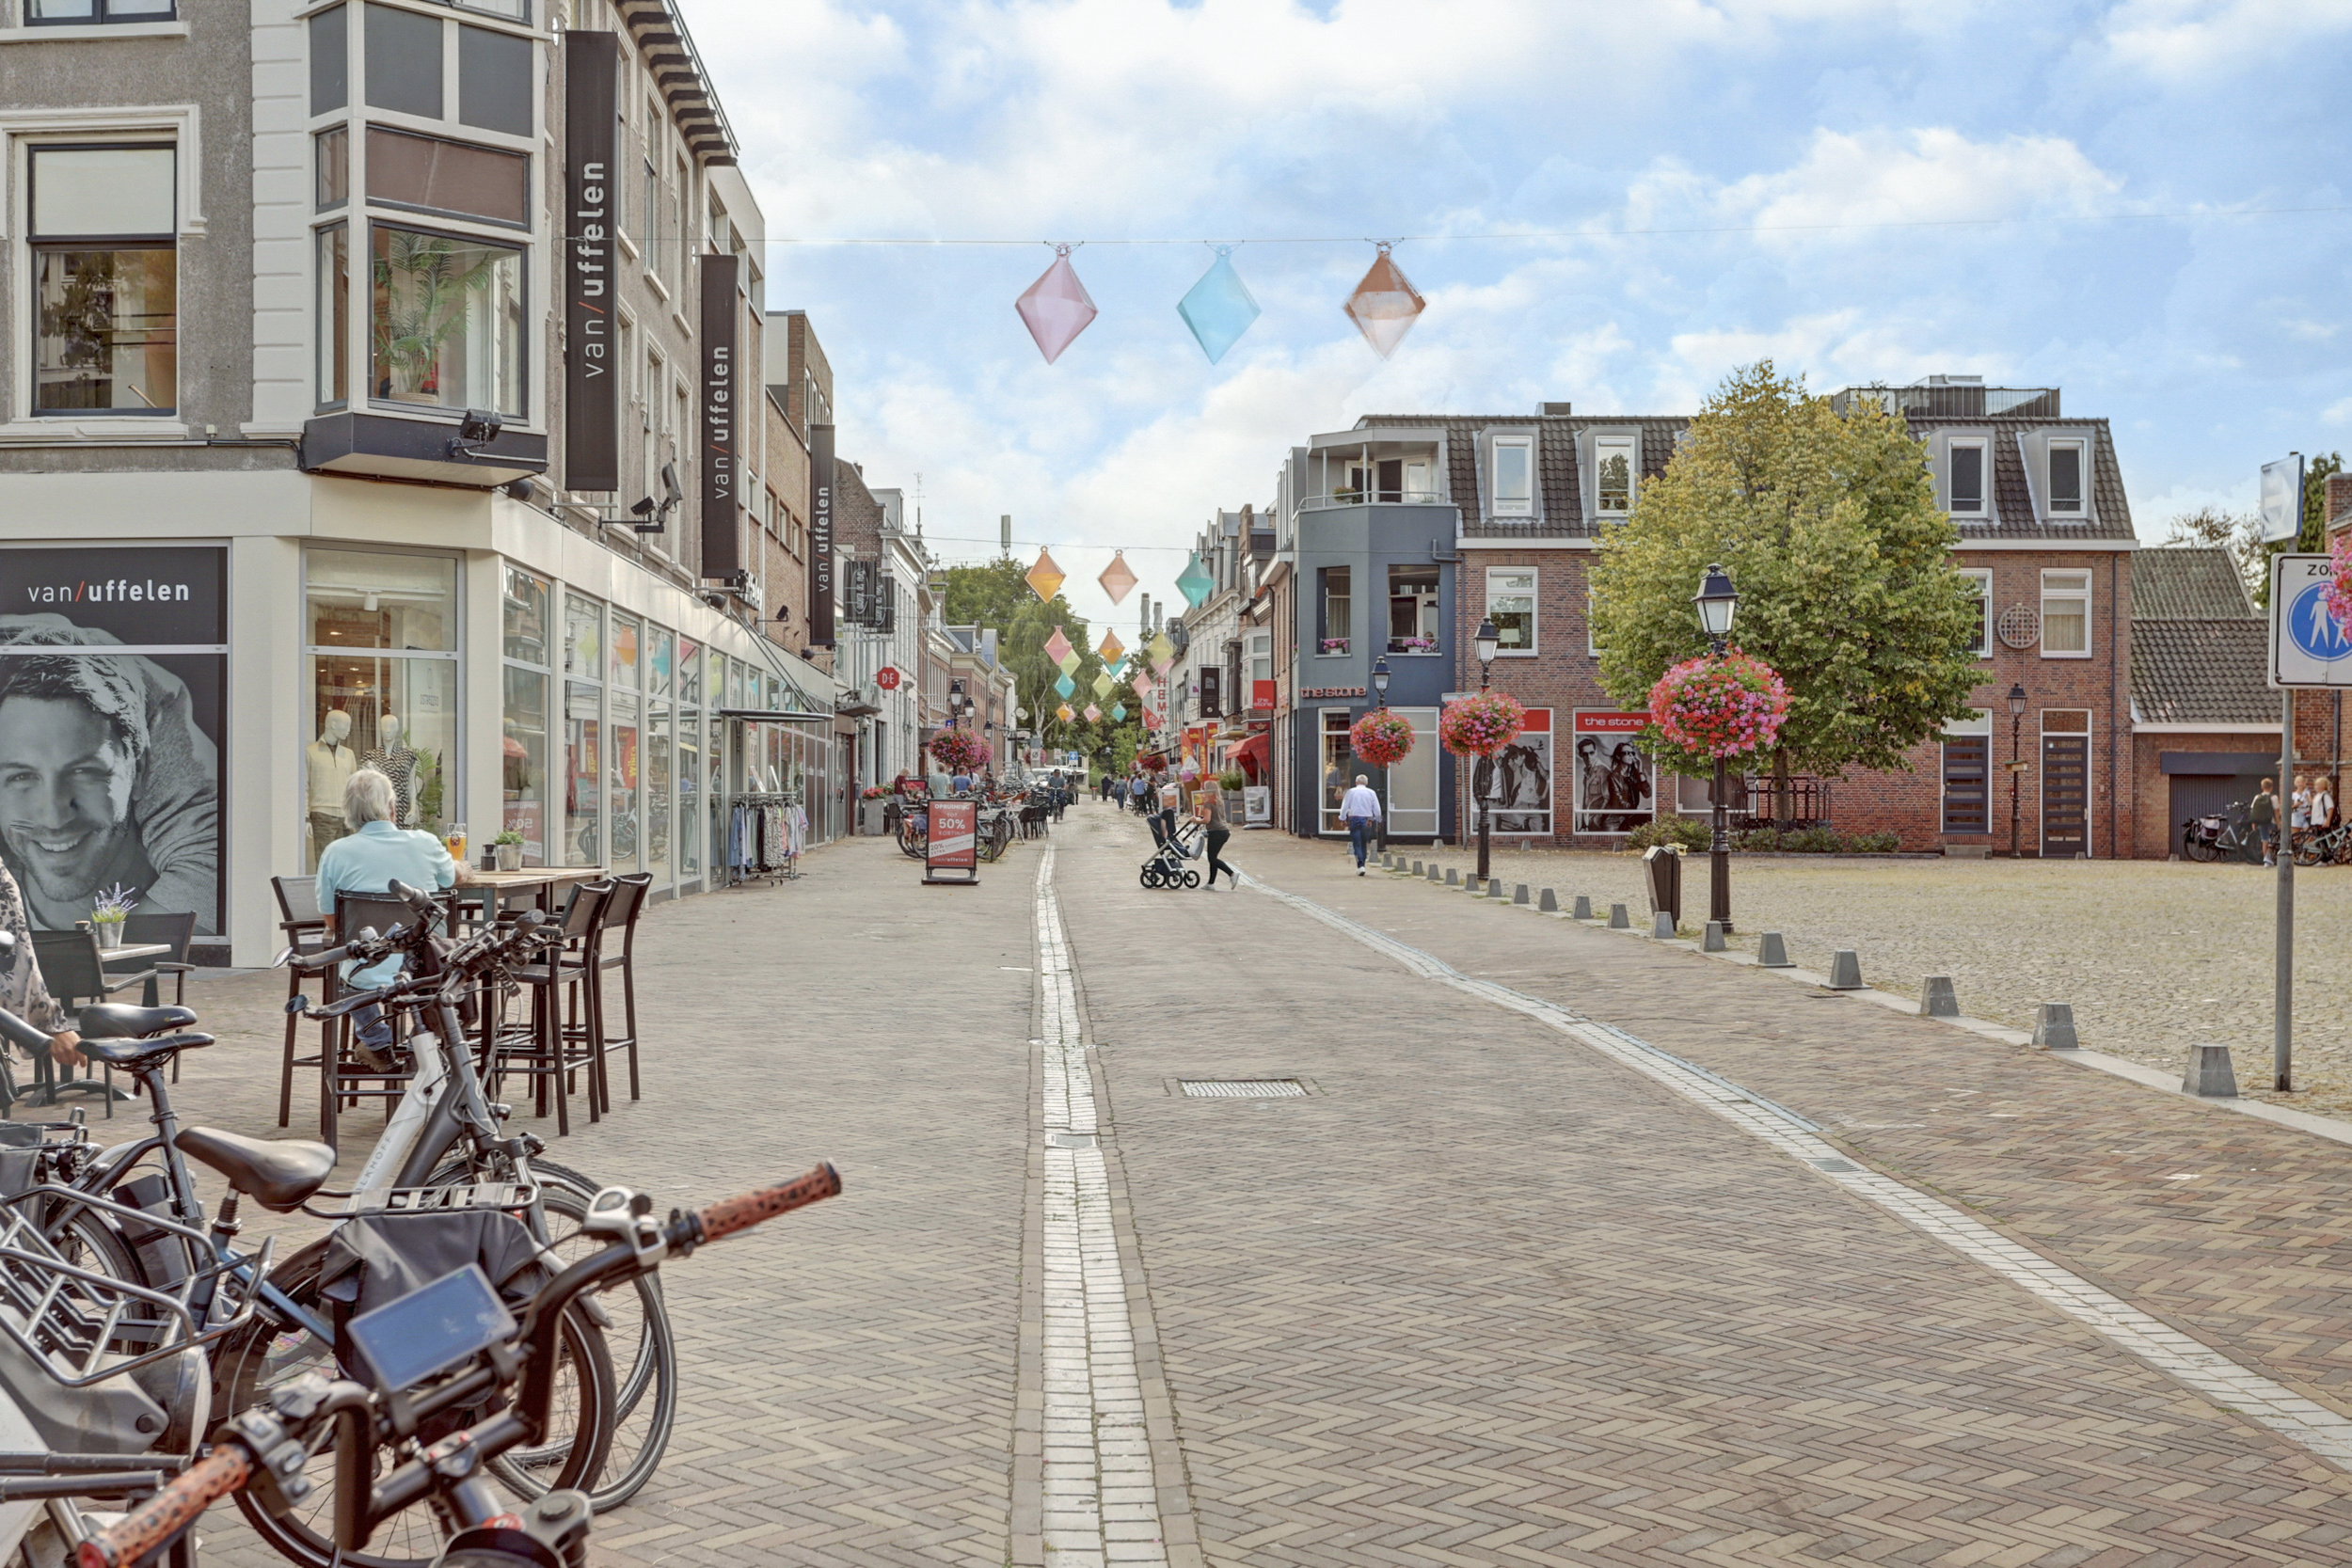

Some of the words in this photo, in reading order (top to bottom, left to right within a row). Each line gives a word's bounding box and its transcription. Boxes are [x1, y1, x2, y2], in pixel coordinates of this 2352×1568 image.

[1300, 687, 1324, 698] the
[1326, 686, 1366, 697] stone
[1156, 677, 1167, 724] HEMA
[1584, 717, 1606, 726] the
[1608, 718, 1644, 726] stone
[938, 817, 966, 830] 50%
